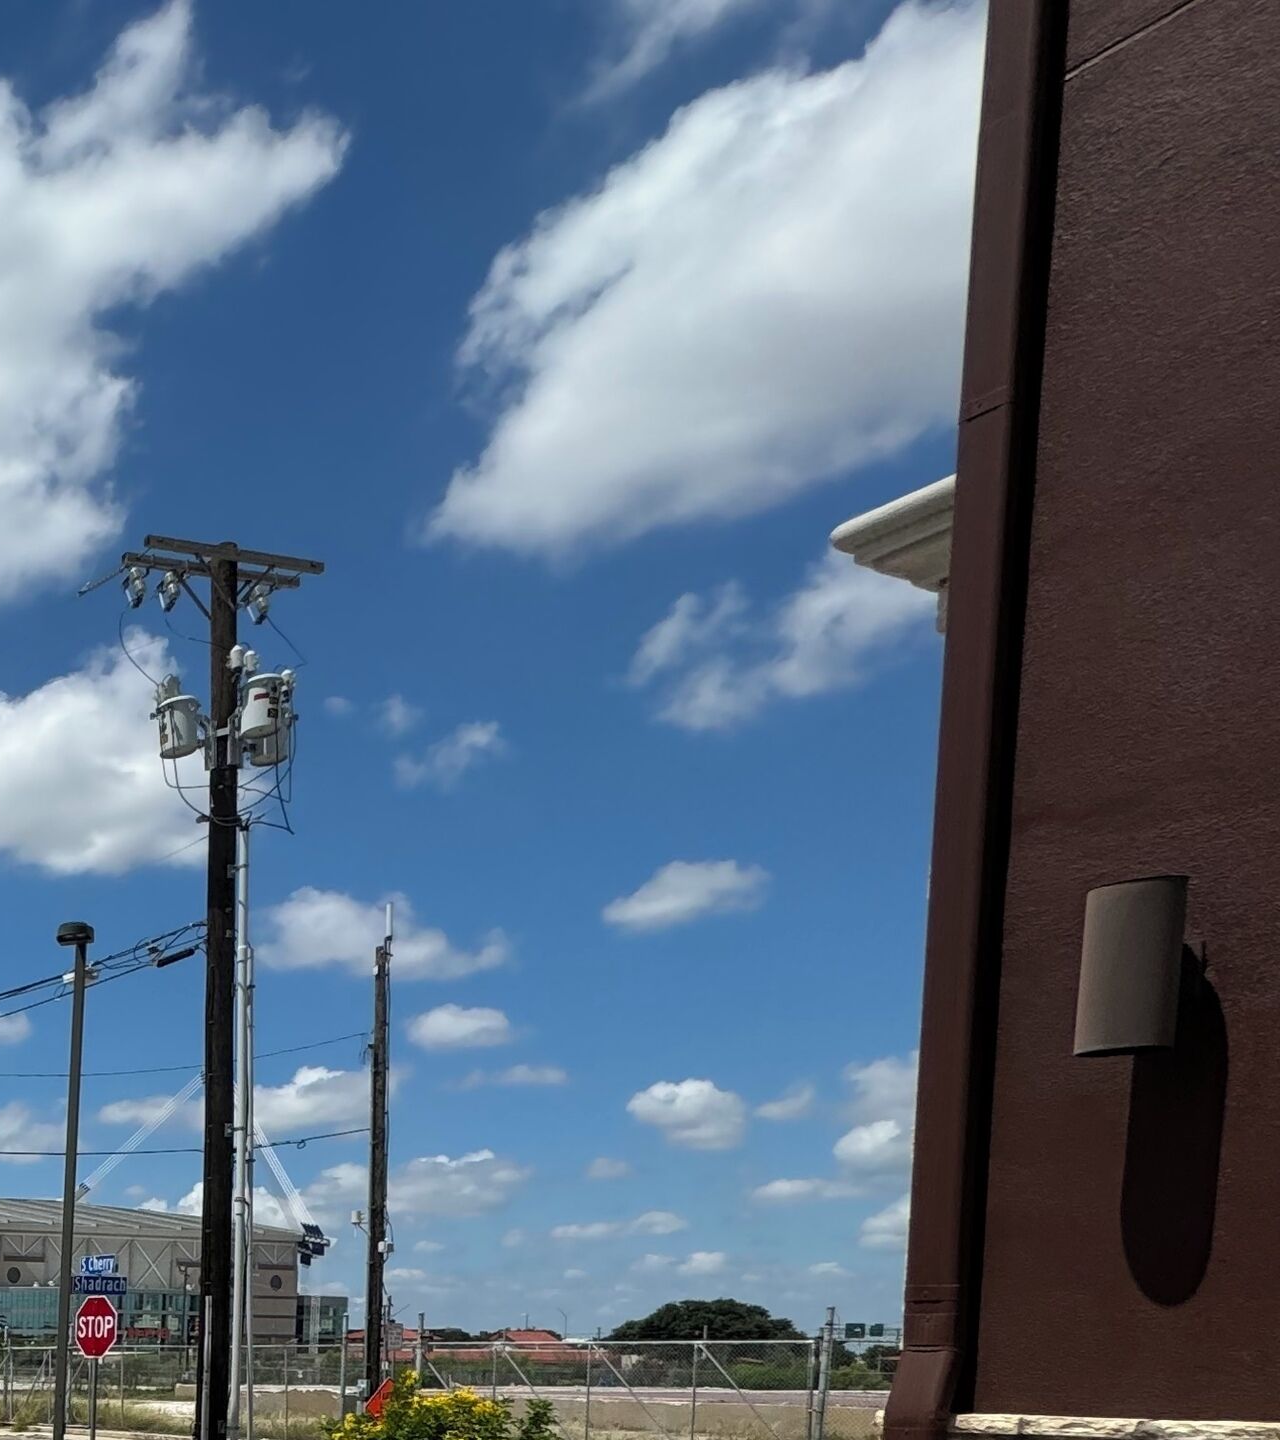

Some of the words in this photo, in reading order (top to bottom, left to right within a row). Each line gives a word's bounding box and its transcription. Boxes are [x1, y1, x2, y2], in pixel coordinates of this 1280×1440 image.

[88, 1257, 114, 1273] Cherry
[74, 1277, 126, 1292] Shadrach
[78, 1315, 114, 1338] STOP
